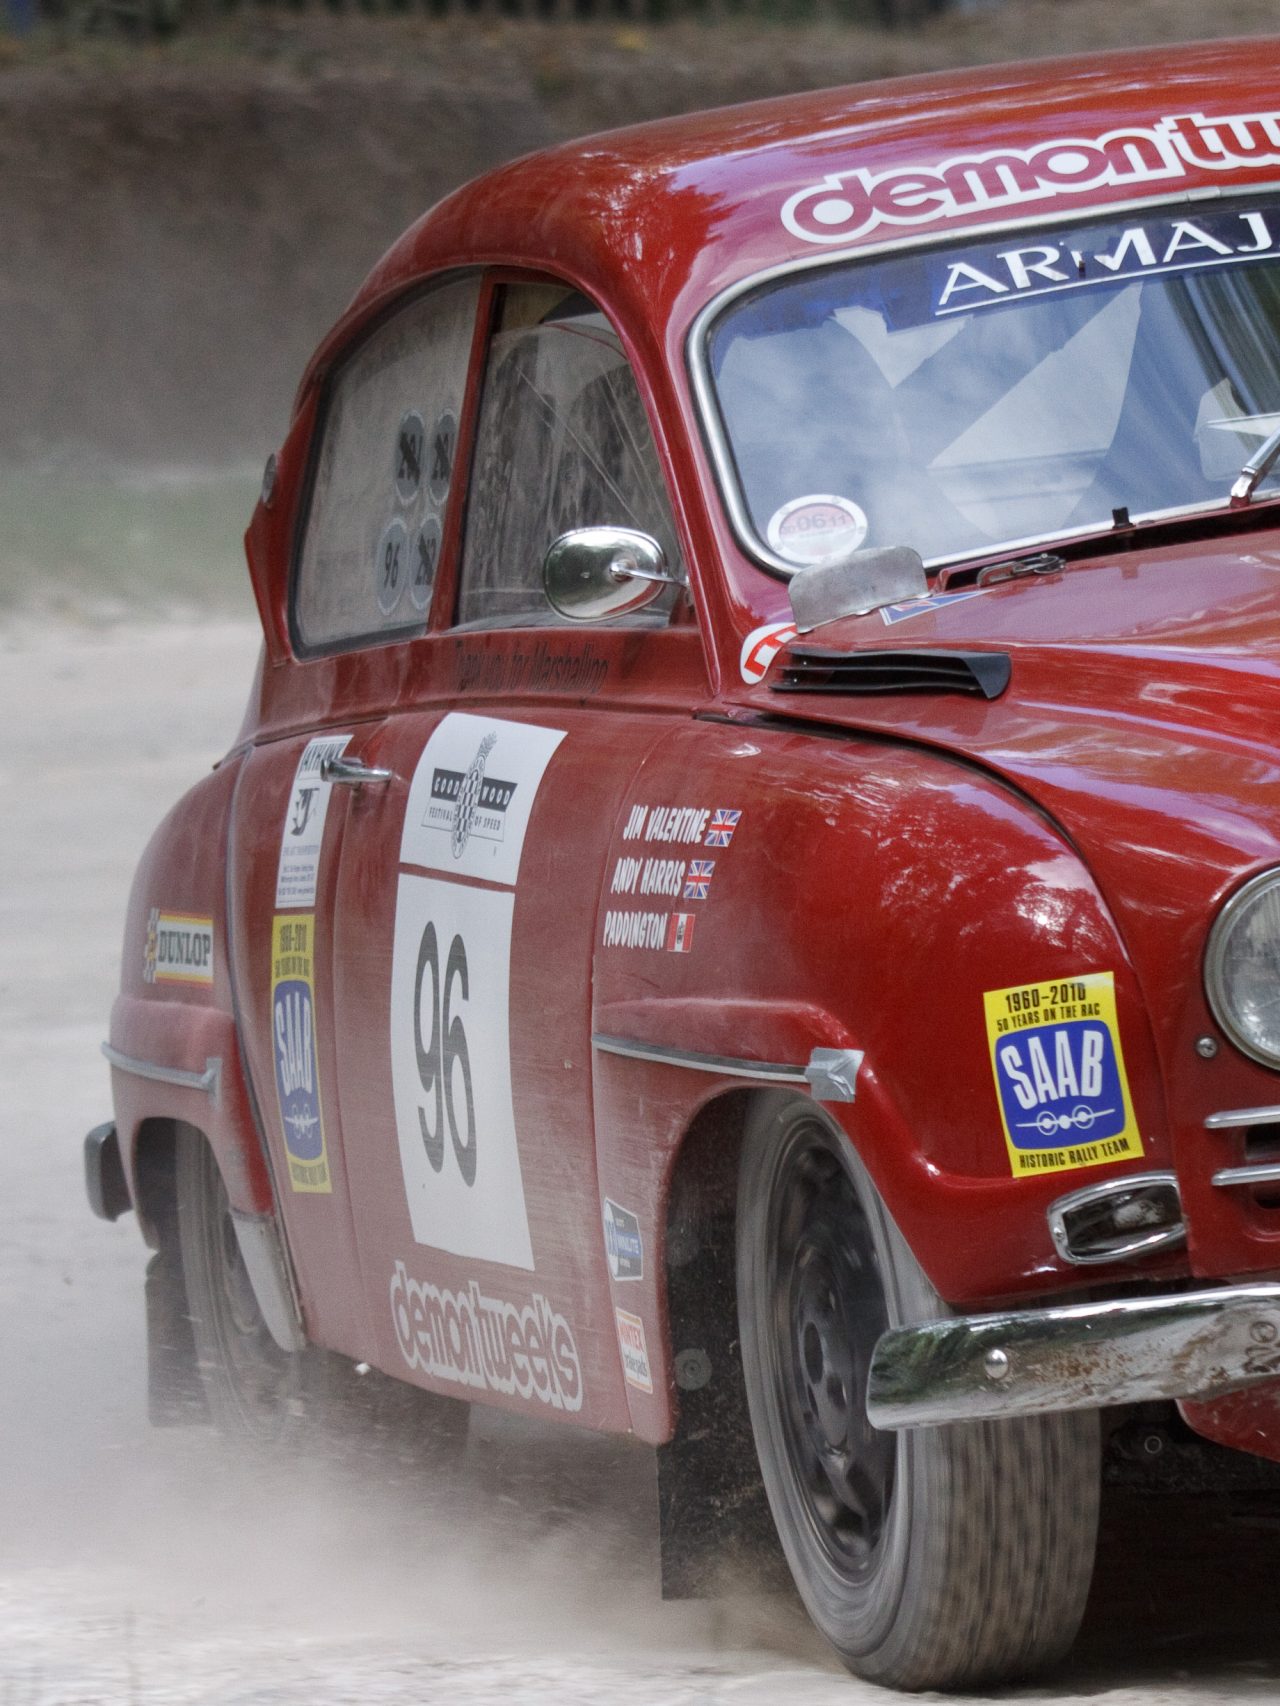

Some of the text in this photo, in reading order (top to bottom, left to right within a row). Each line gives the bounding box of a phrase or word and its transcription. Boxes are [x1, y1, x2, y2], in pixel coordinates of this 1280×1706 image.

[623, 805, 711, 844] JIM VALENTINE
[611, 857, 686, 897] ANDY HARRIS
[158, 930, 211, 967] DUNLOP
[602, 911, 668, 950] PADDINGTON
[1005, 982, 1087, 1013] 1960-2010
[997, 1002, 1101, 1033] 50 YEARS ON THE RAC
[275, 991, 312, 1096] SAAB
[413, 920, 477, 1187] 96
[1000, 1030, 1104, 1110] SAAB
[1019, 1137, 1131, 1170] HISTORIC RALLY TEAM
